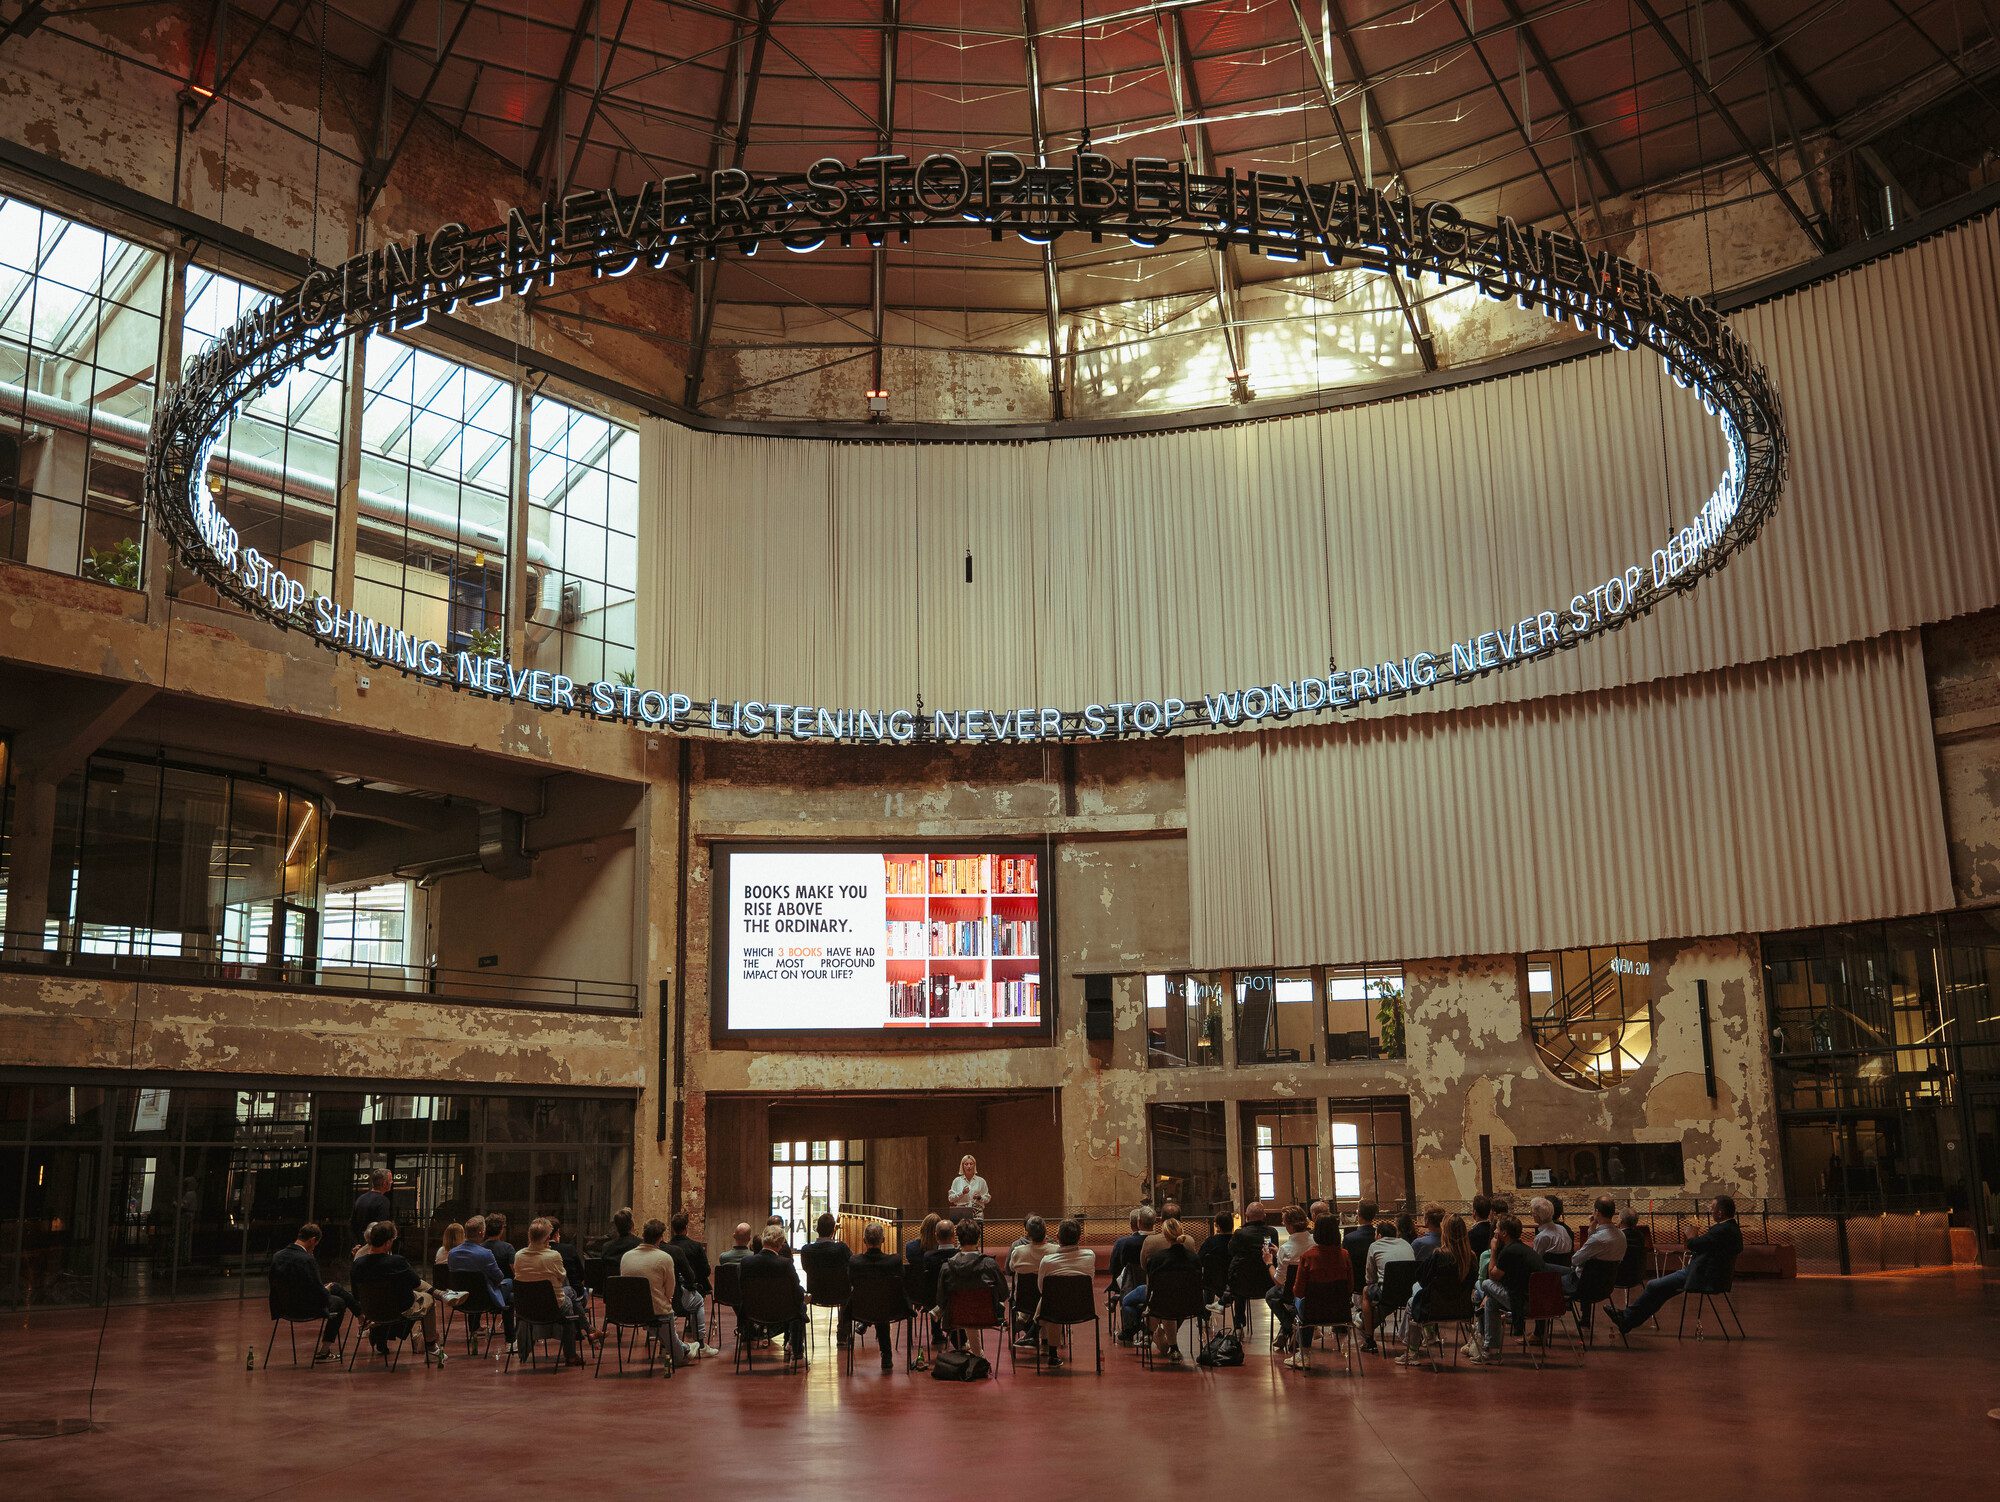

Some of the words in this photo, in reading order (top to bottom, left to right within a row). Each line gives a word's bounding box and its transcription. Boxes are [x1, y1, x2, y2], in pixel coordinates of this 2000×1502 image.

[507, 168, 750, 259] NEVER
[806, 151, 1026, 216] STOP
[1076, 152, 1468, 257] BELIEVING
[1504, 214, 1671, 326] NEVER
[244, 547, 305, 615] STOP
[315, 596, 442, 677] SHINING
[456, 650, 574, 707] NEVER
[592, 681, 692, 724] STOP
[711, 698, 915, 740] LISTENING
[935, 709, 1062, 741] NEVER
[1084, 698, 1185, 736] STOP
[1204, 651, 1436, 724] WONDERING
[1450, 609, 1560, 675] NEVER
[1570, 565, 1642, 632] STOP
[744, 885, 790, 900] BOOKS
[795, 885, 834, 899] MAKE
[839, 885, 868, 899] YOU
[744, 902, 772, 916] RISE
[777, 902, 823, 916] ABOVE
[743, 919, 771, 933] THE
[774, 919, 853, 933] ORDINARY.
[743, 947, 774, 958] WHICH
[778, 947, 785, 957] 3
[788, 947, 823, 957] BOOKS
[826, 947, 852, 957] HAVE
[855, 947, 875, 957] HAD
[743, 959, 760, 969] THE
[775, 958, 805, 969] MOST
[820, 958, 876, 968] PROFOUND
[743, 970, 778, 980] IMPACT
[780, 970, 798, 980] ON
[801, 970, 828, 980] YOUR
[831, 969, 854, 980] LIFE?
